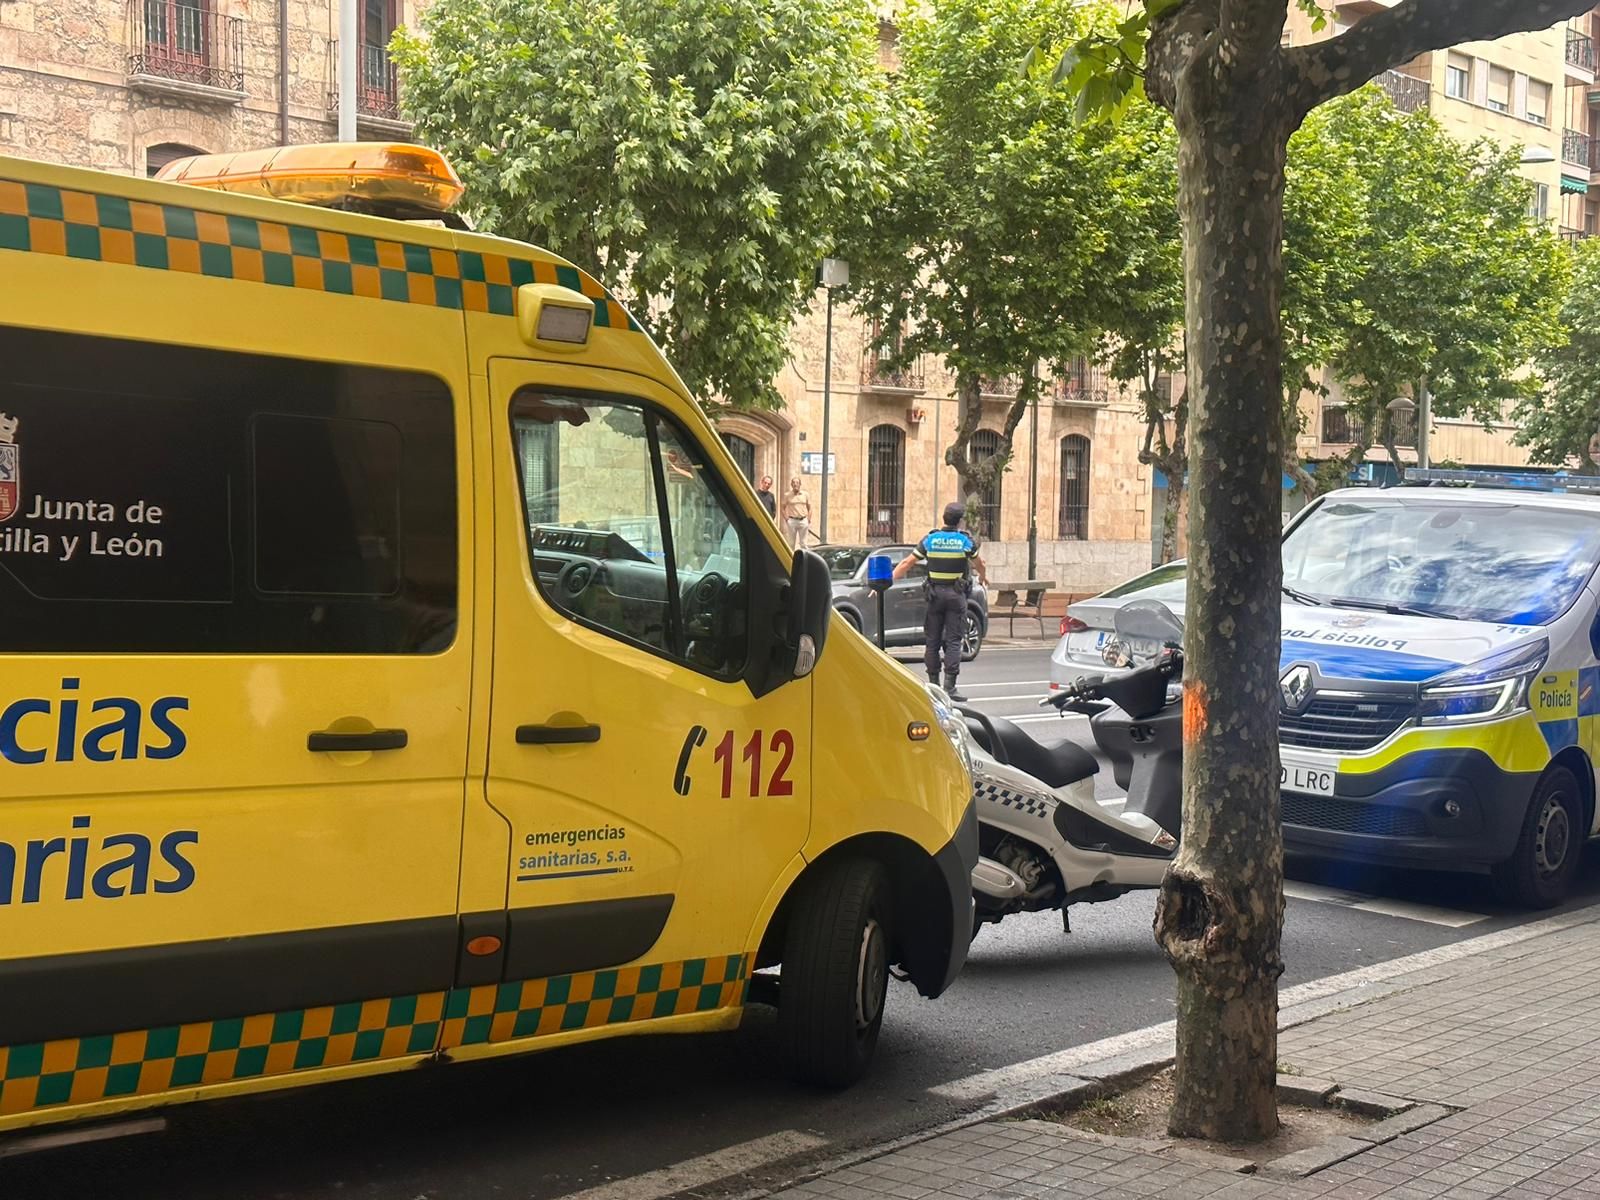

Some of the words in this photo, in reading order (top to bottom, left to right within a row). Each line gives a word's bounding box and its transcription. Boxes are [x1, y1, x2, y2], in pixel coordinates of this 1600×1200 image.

[26, 494, 115, 522] Junta
[125, 500, 163, 524] de
[0, 527, 49, 553] illa
[59, 535, 79, 561] y
[90, 531, 163, 557] León
[1496, 625, 1531, 634] 715
[1540, 689, 1572, 708] Policía
[714, 729, 795, 799] 112
[1294, 768, 1330, 791] LRC
[525, 824, 626, 846] emergencias
[0, 816, 199, 906] rias
[519, 849, 601, 869] sanitarias,
[606, 850, 631, 862] s.a.
